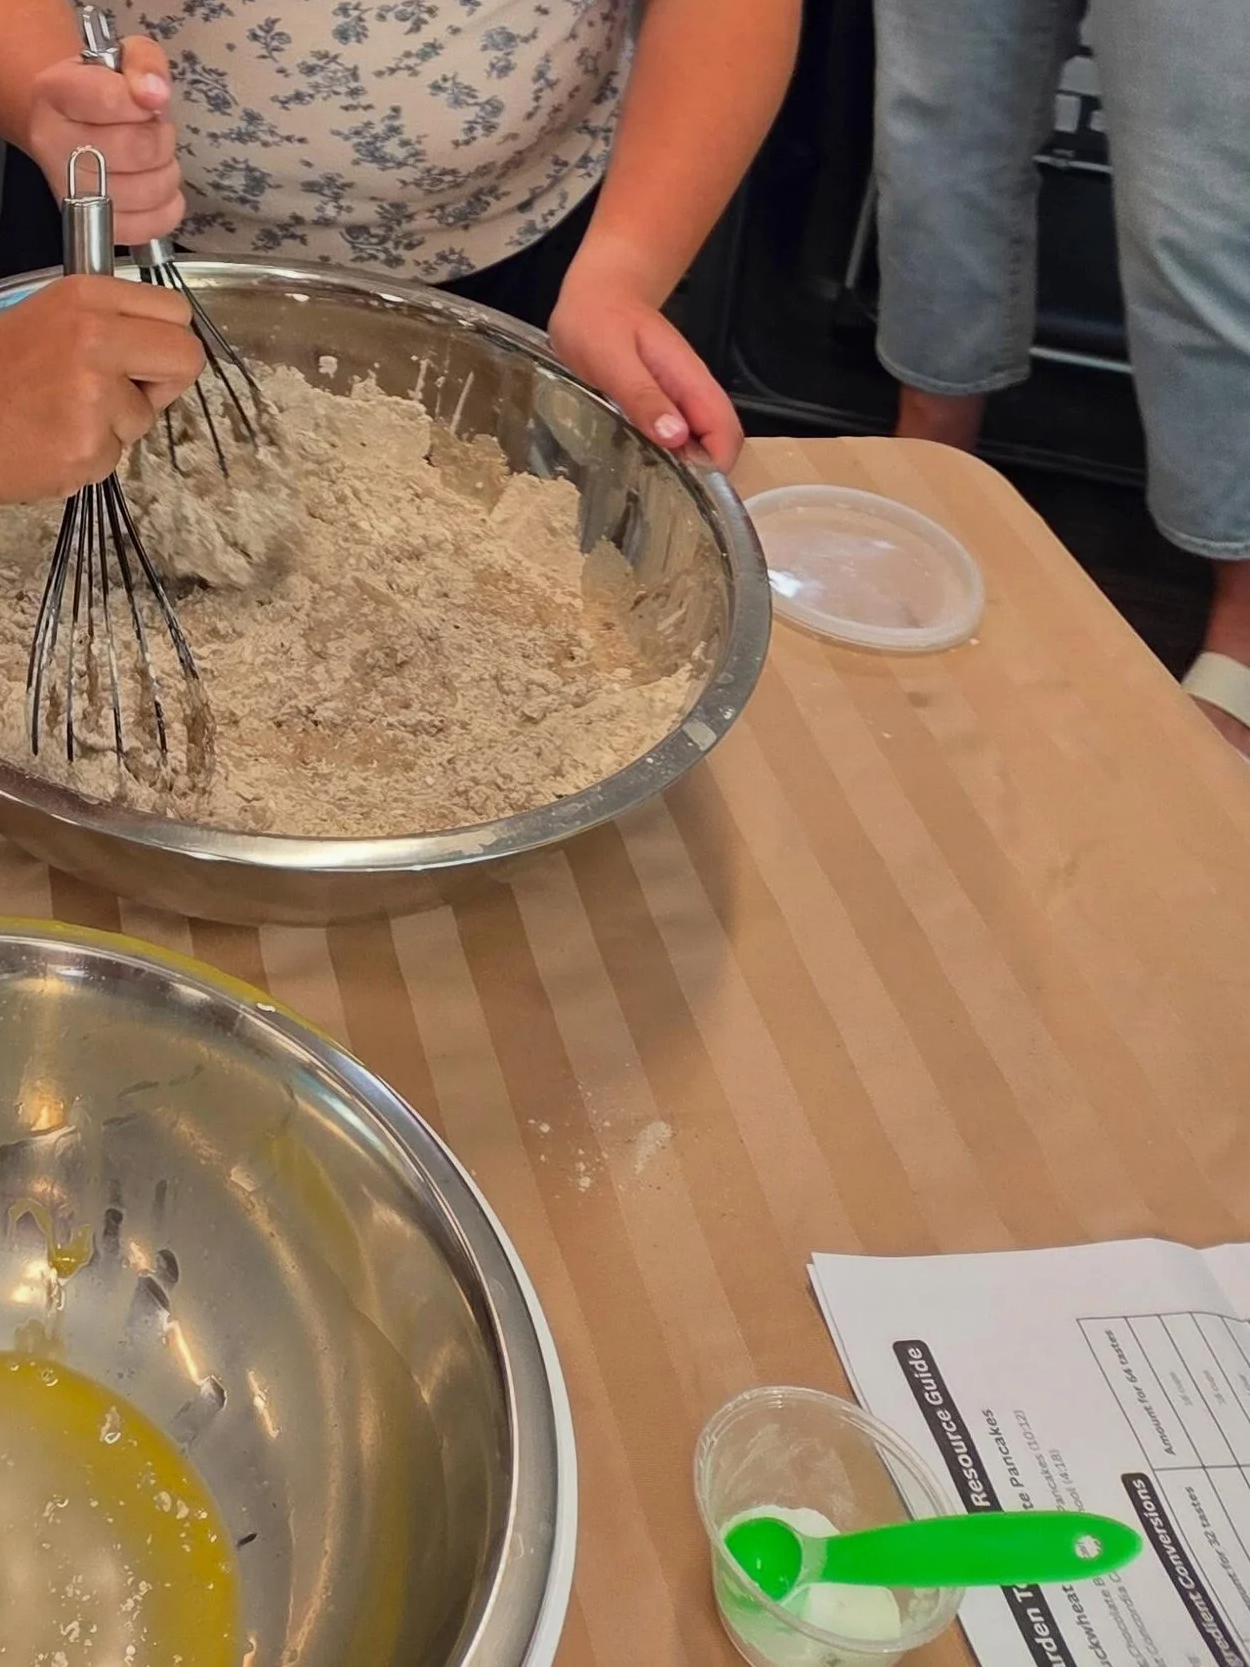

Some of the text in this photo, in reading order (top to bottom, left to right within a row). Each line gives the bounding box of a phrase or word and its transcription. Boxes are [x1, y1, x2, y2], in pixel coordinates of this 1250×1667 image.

[908, 1346, 944, 1406] Guide
[1105, 1329, 1176, 1456] Amount for 64 tastes
[936, 1409, 991, 1507] Resource
[982, 1408, 1025, 1488] Pancakes
[1132, 1478, 1196, 1590] Conversions
[1185, 1486, 1211, 1528] tastes
[1204, 1531, 1220, 1546] 32
[1216, 1548, 1232, 1571] for
